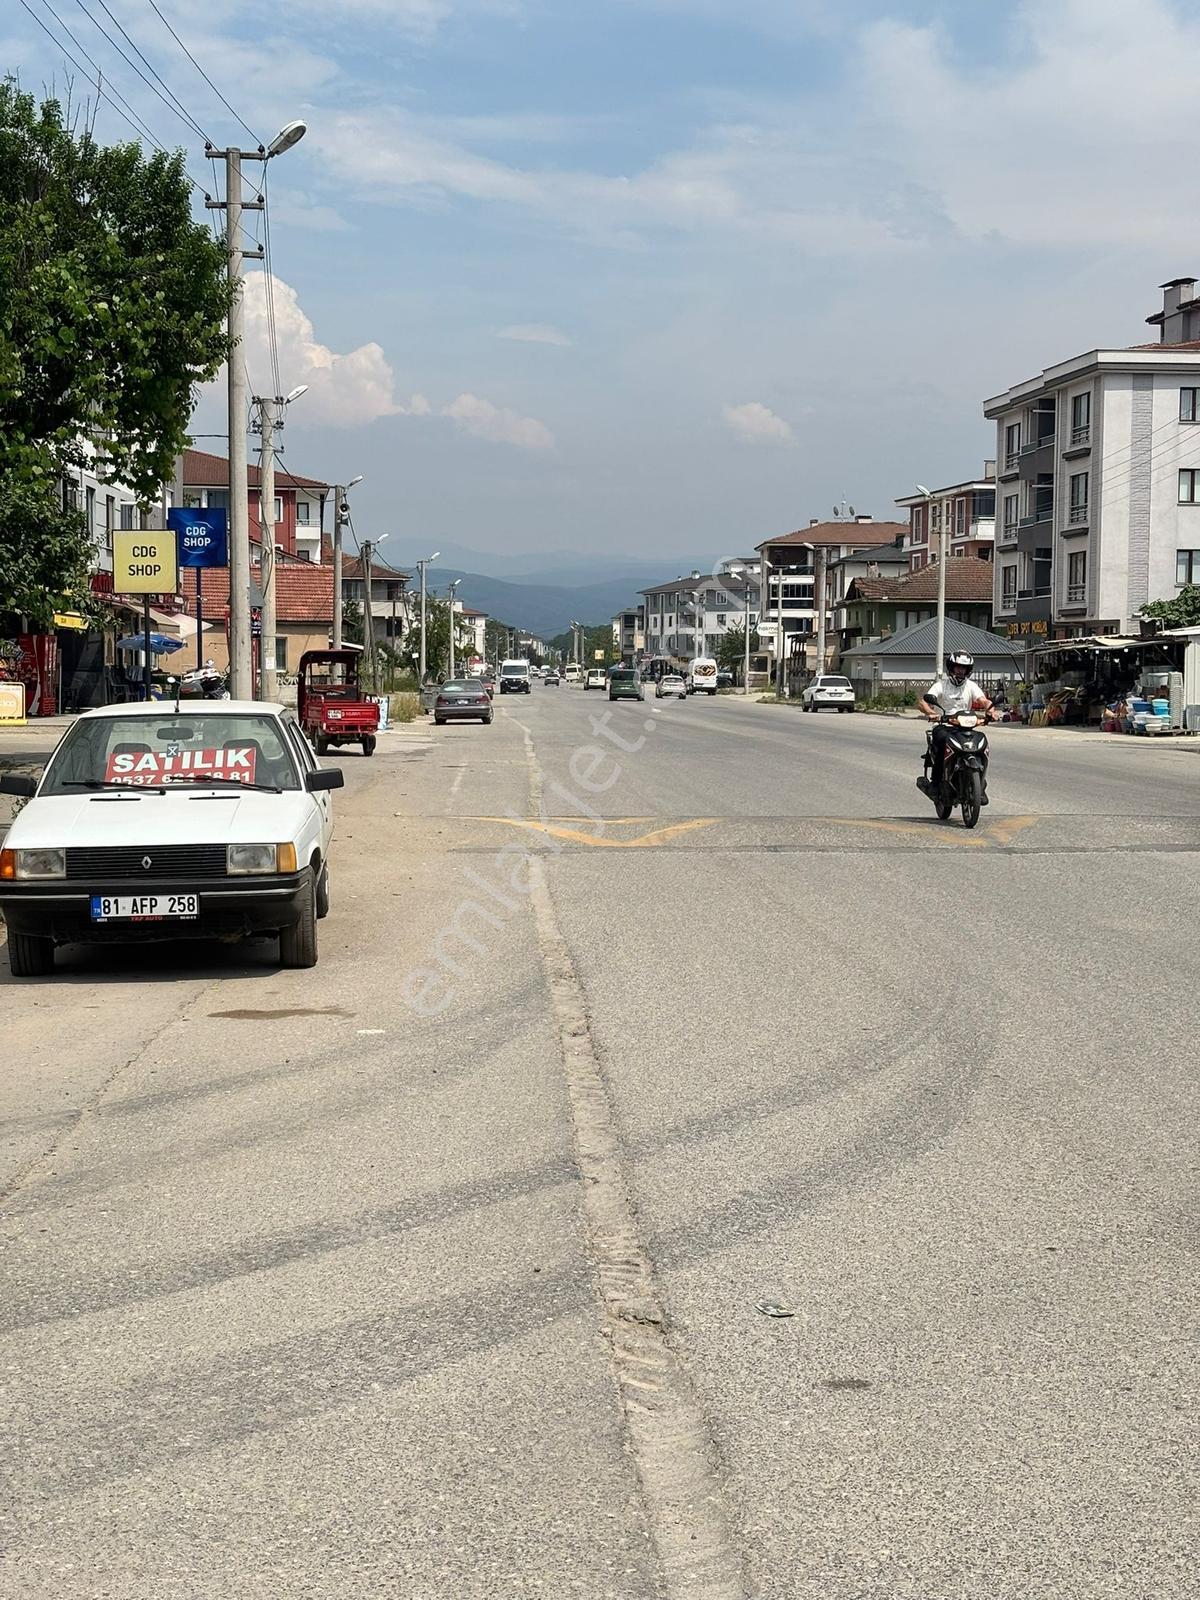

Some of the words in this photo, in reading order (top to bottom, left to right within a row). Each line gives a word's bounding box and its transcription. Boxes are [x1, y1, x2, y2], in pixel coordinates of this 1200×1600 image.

[186, 526, 206, 536] CDG
[184, 537, 211, 547] SHOP
[132, 546, 157, 558] CDG
[128, 564, 162, 576] SHOP
[113, 748, 252, 773] SATILIK
[110, 774, 157, 785] 0537
[230, 771, 250, 782] 81
[102, 898, 119, 915] 81
[131, 897, 158, 914] AFP
[168, 896, 196, 913] 258
